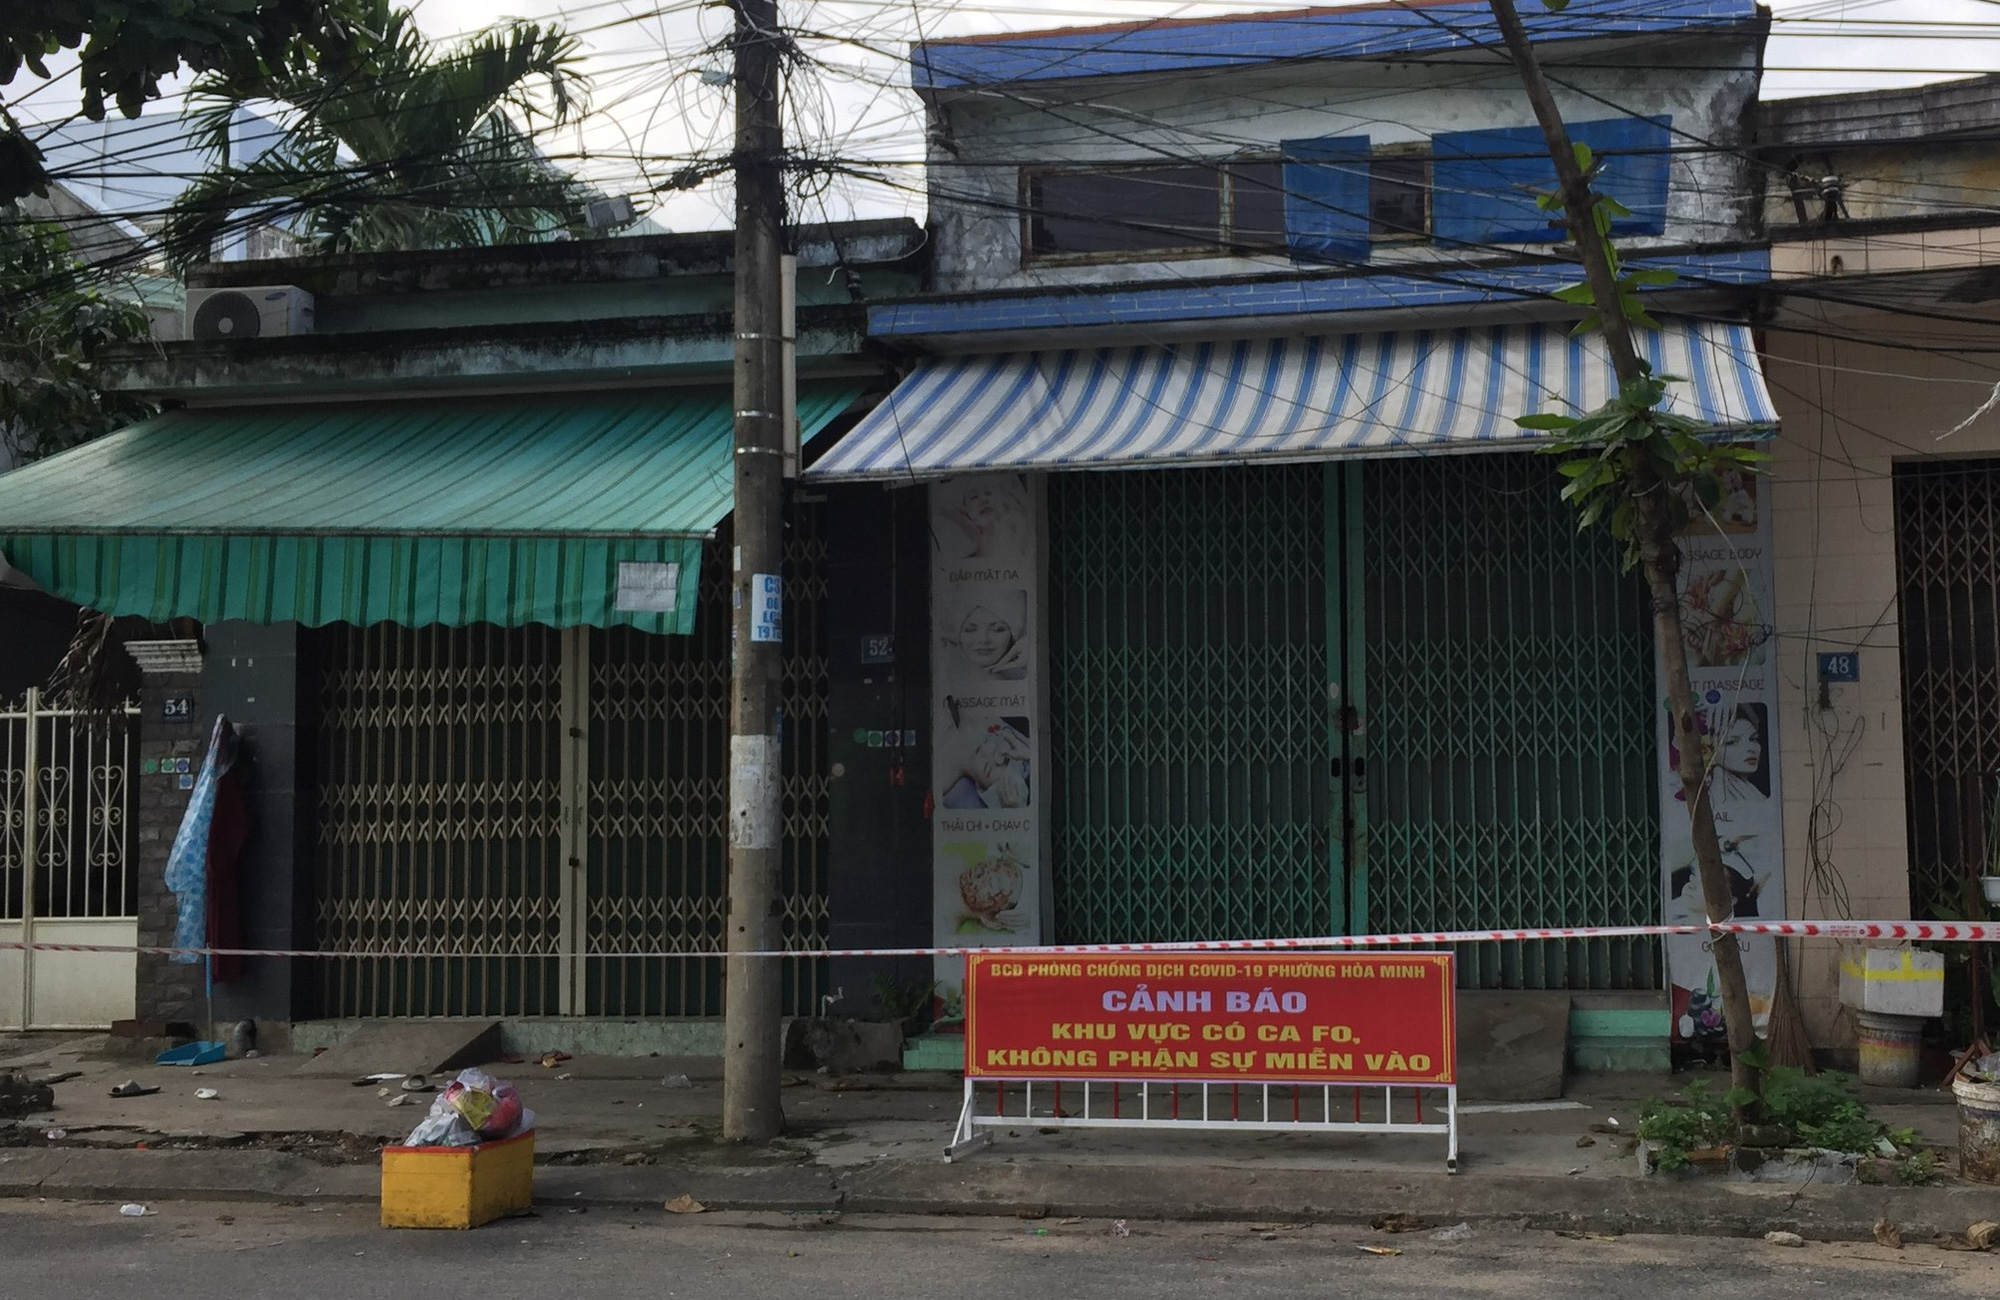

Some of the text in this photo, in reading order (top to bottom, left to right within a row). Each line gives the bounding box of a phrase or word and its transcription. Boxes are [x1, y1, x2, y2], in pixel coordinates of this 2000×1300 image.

[1680, 548, 1762, 561] SSAGE BODY
[869, 639, 888, 656] 52
[1828, 655, 1849, 674] 48
[1703, 679, 1765, 691] MASSAGE
[164, 698, 189, 715] 54
[1713, 811, 1734, 823] AIL
[1028, 962, 1082, 977] PHÒNG
[1087, 961, 1141, 977] CHỐNG
[1147, 965, 1184, 980] DỊCH
[1189, 964, 1262, 977] COVID-19
[1268, 961, 1336, 978] PHƯỜNG
[1341, 962, 1375, 978] HÒA
[1380, 965, 1426, 979] MINH
[1102, 983, 1307, 1013] CẢNH BÁO
[1052, 1021, 1361, 1045] KHU VỰC CÓ CA FO,
[987, 1046, 1431, 1072] KHÔNG PHẬN SỰ MIỄN VÀO
